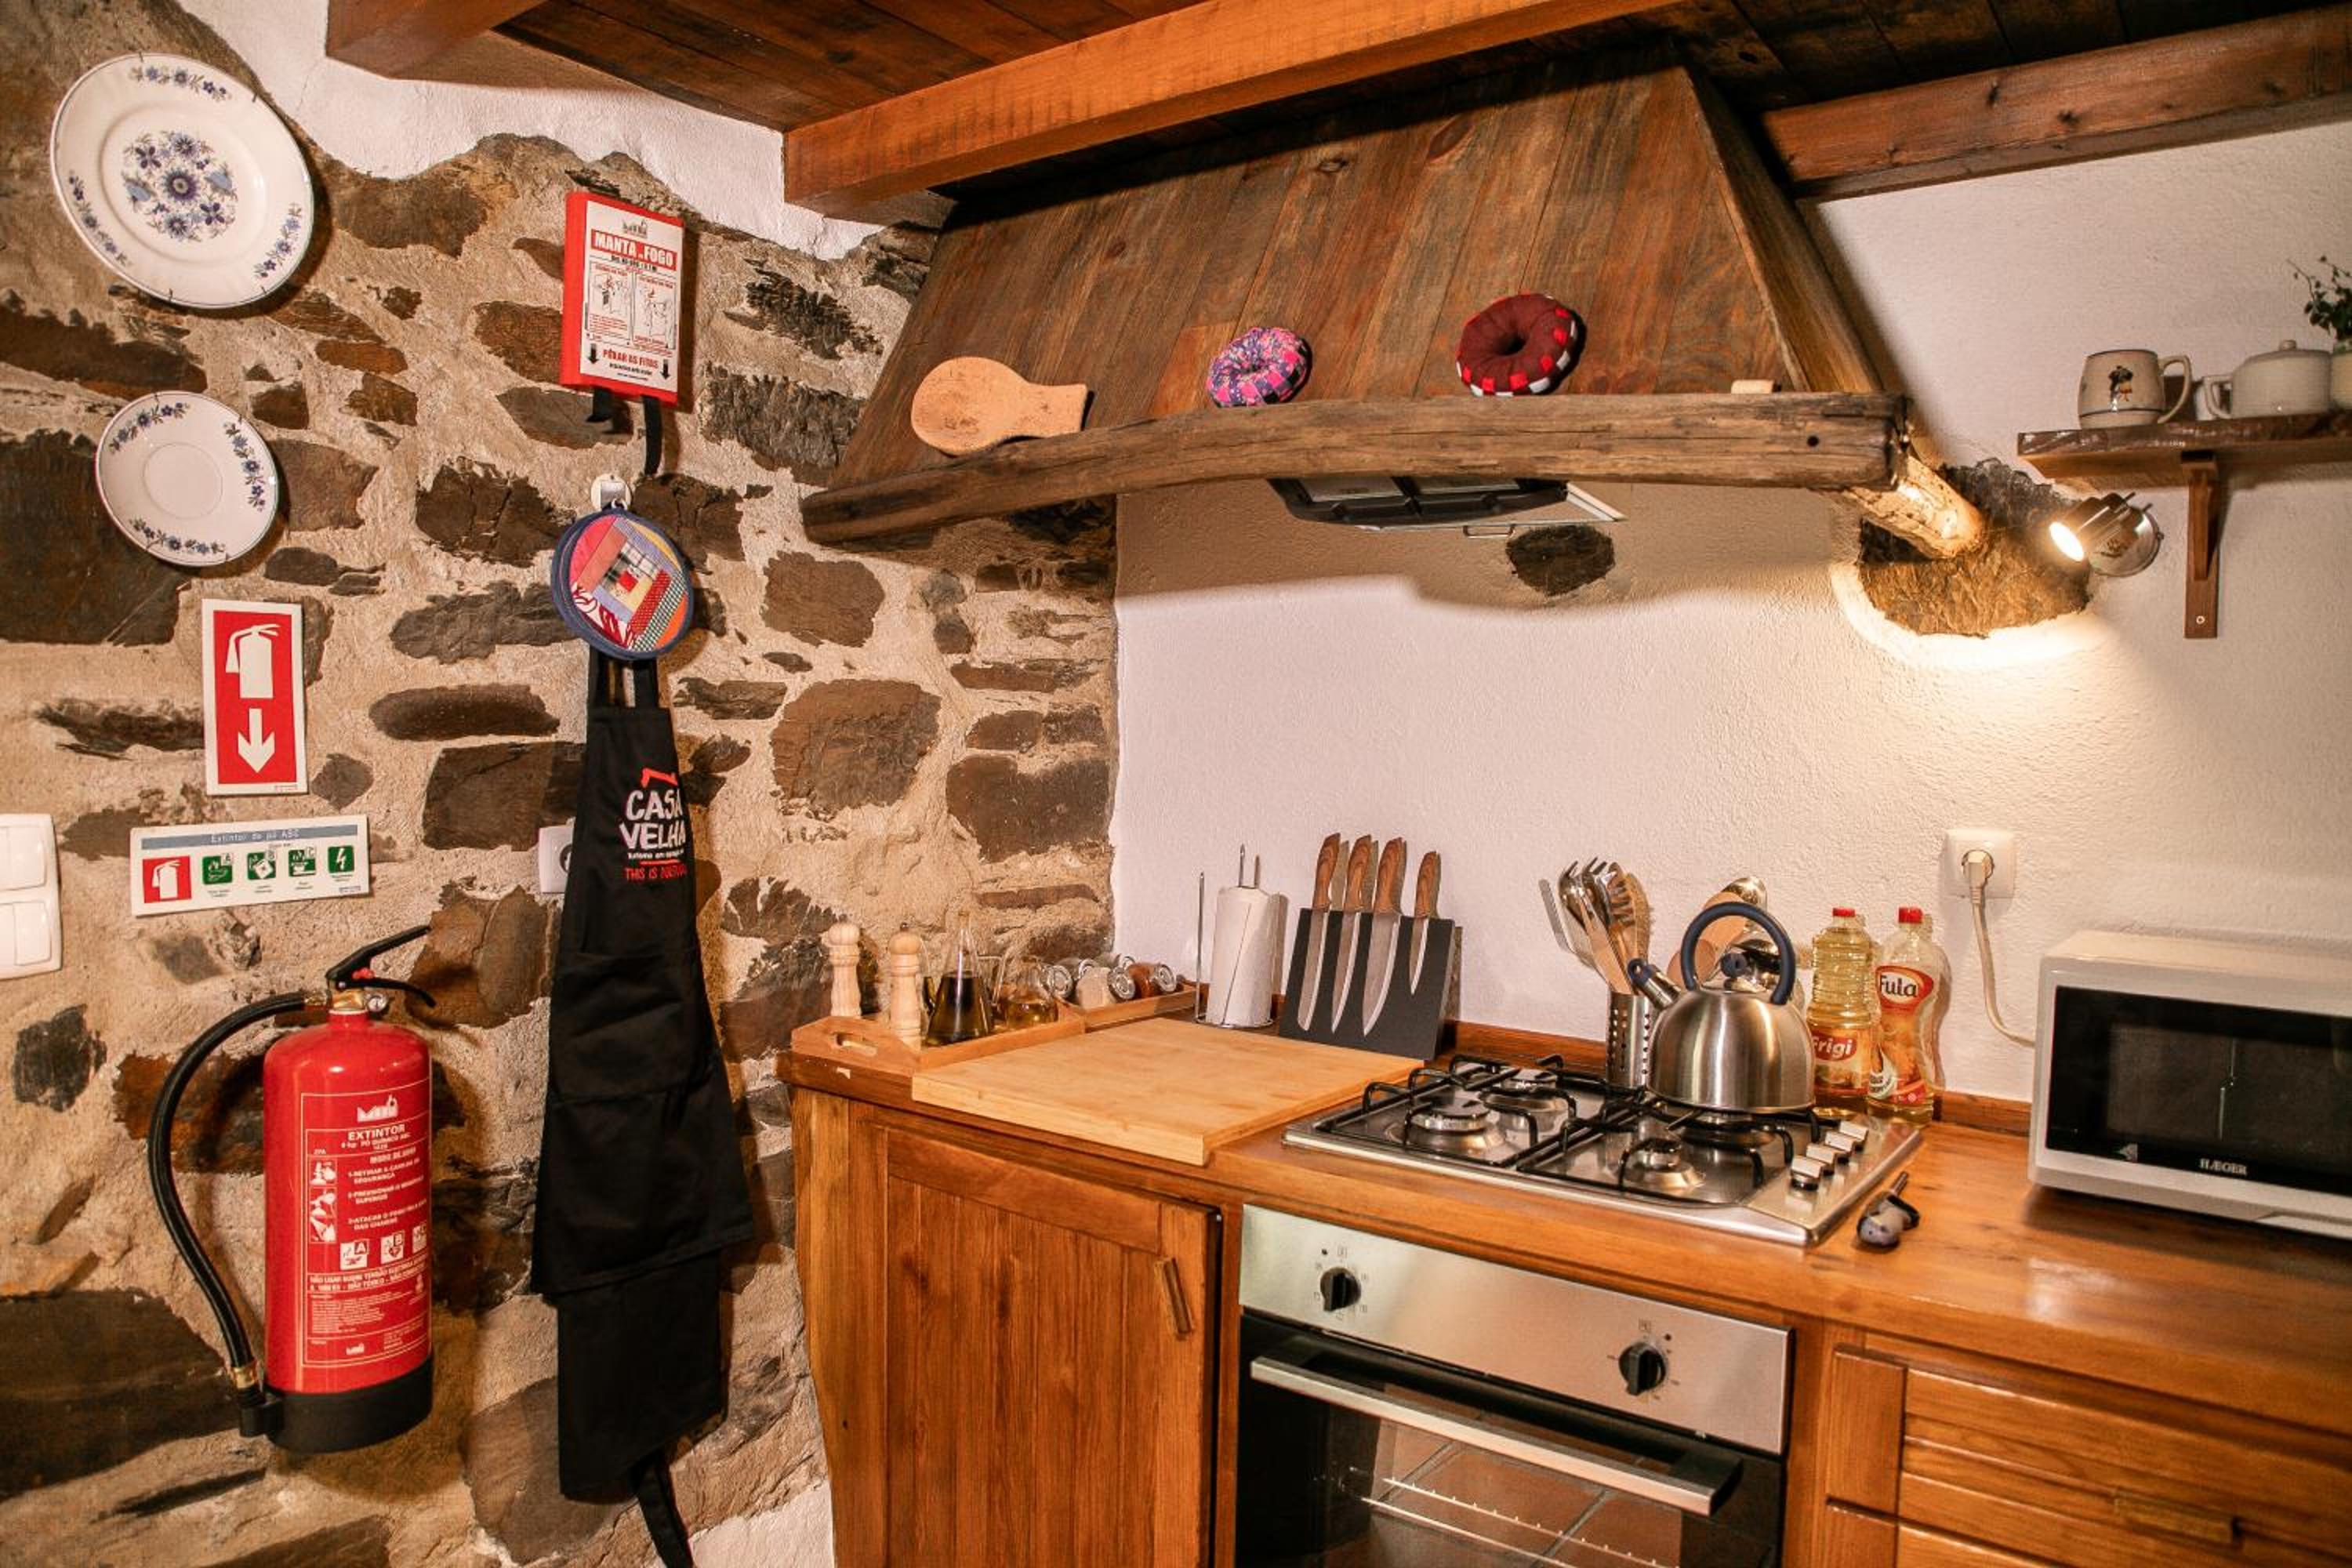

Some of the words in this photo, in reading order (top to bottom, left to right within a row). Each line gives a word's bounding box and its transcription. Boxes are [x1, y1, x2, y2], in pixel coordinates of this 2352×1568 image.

[595, 232, 637, 257] MANTA
[644, 247, 673, 267] FOGO
[626, 789, 683, 821] CASA
[281, 829, 299, 838] ABC
[619, 820, 686, 850] VELHA
[626, 867, 644, 880] THIS
[1879, 975, 1918, 998] Fula
[348, 1124, 405, 1141] EXTINTOR
[357, 1242, 366, 1254] A
[395, 1233, 403, 1247] B
